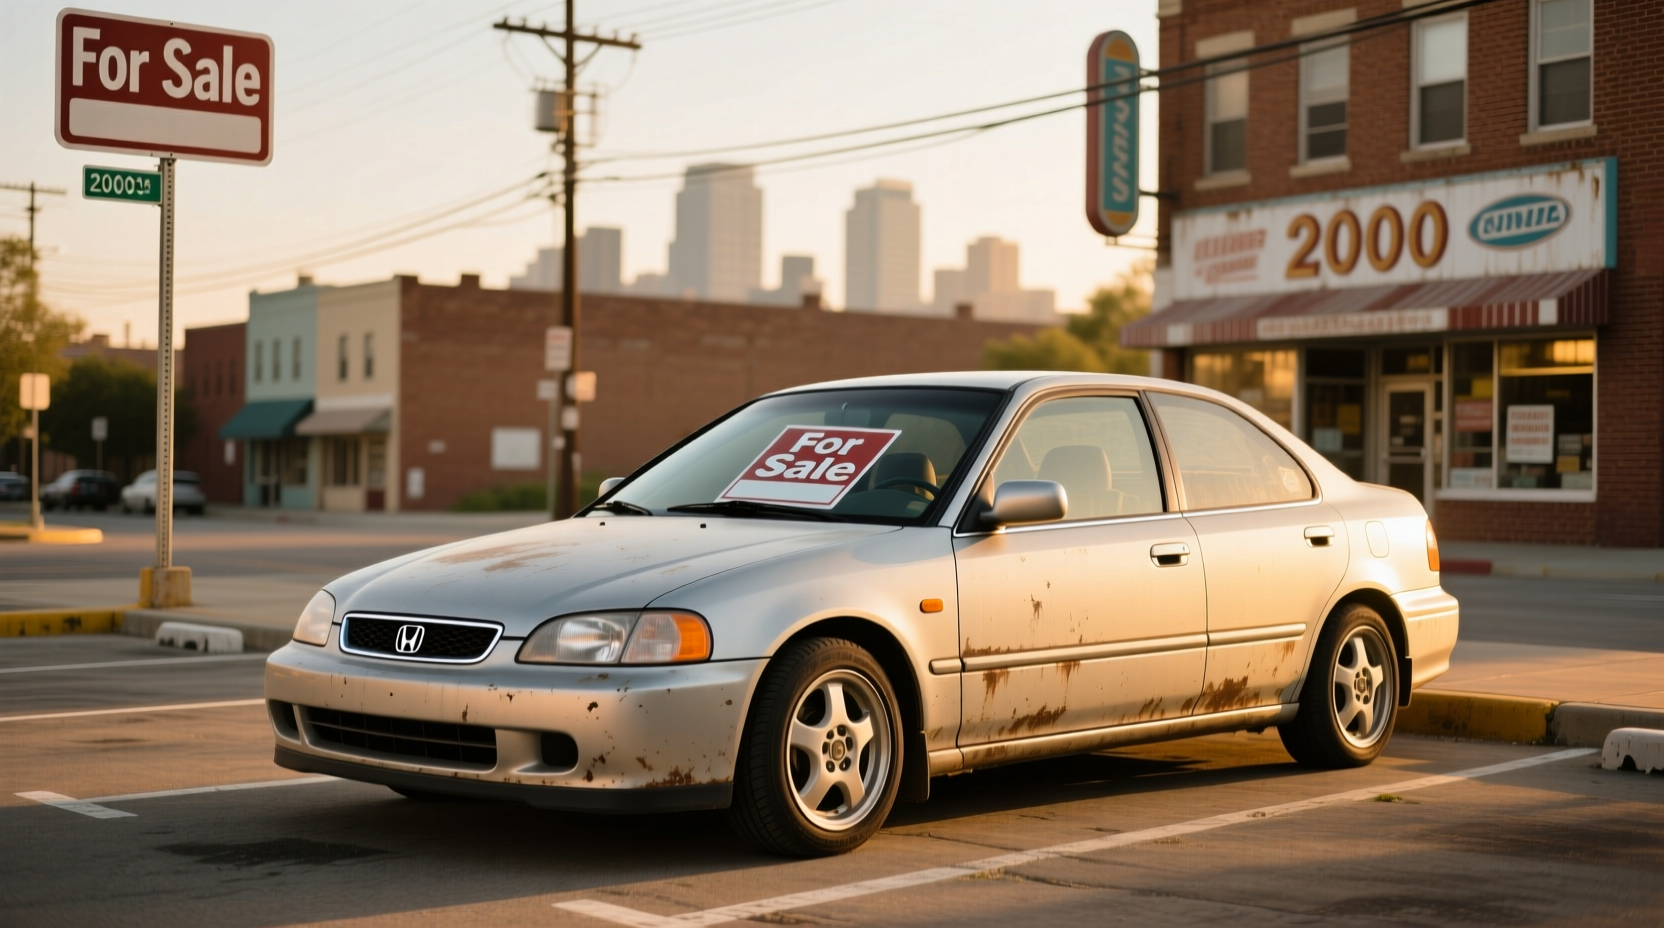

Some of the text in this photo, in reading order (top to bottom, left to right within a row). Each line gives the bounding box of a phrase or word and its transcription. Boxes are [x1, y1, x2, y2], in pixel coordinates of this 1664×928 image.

[72, 26, 261, 106] For Sale
[1285, 200, 1449, 280] 2000
[754, 453, 856, 481] Sale
[789, 432, 864, 455] For
